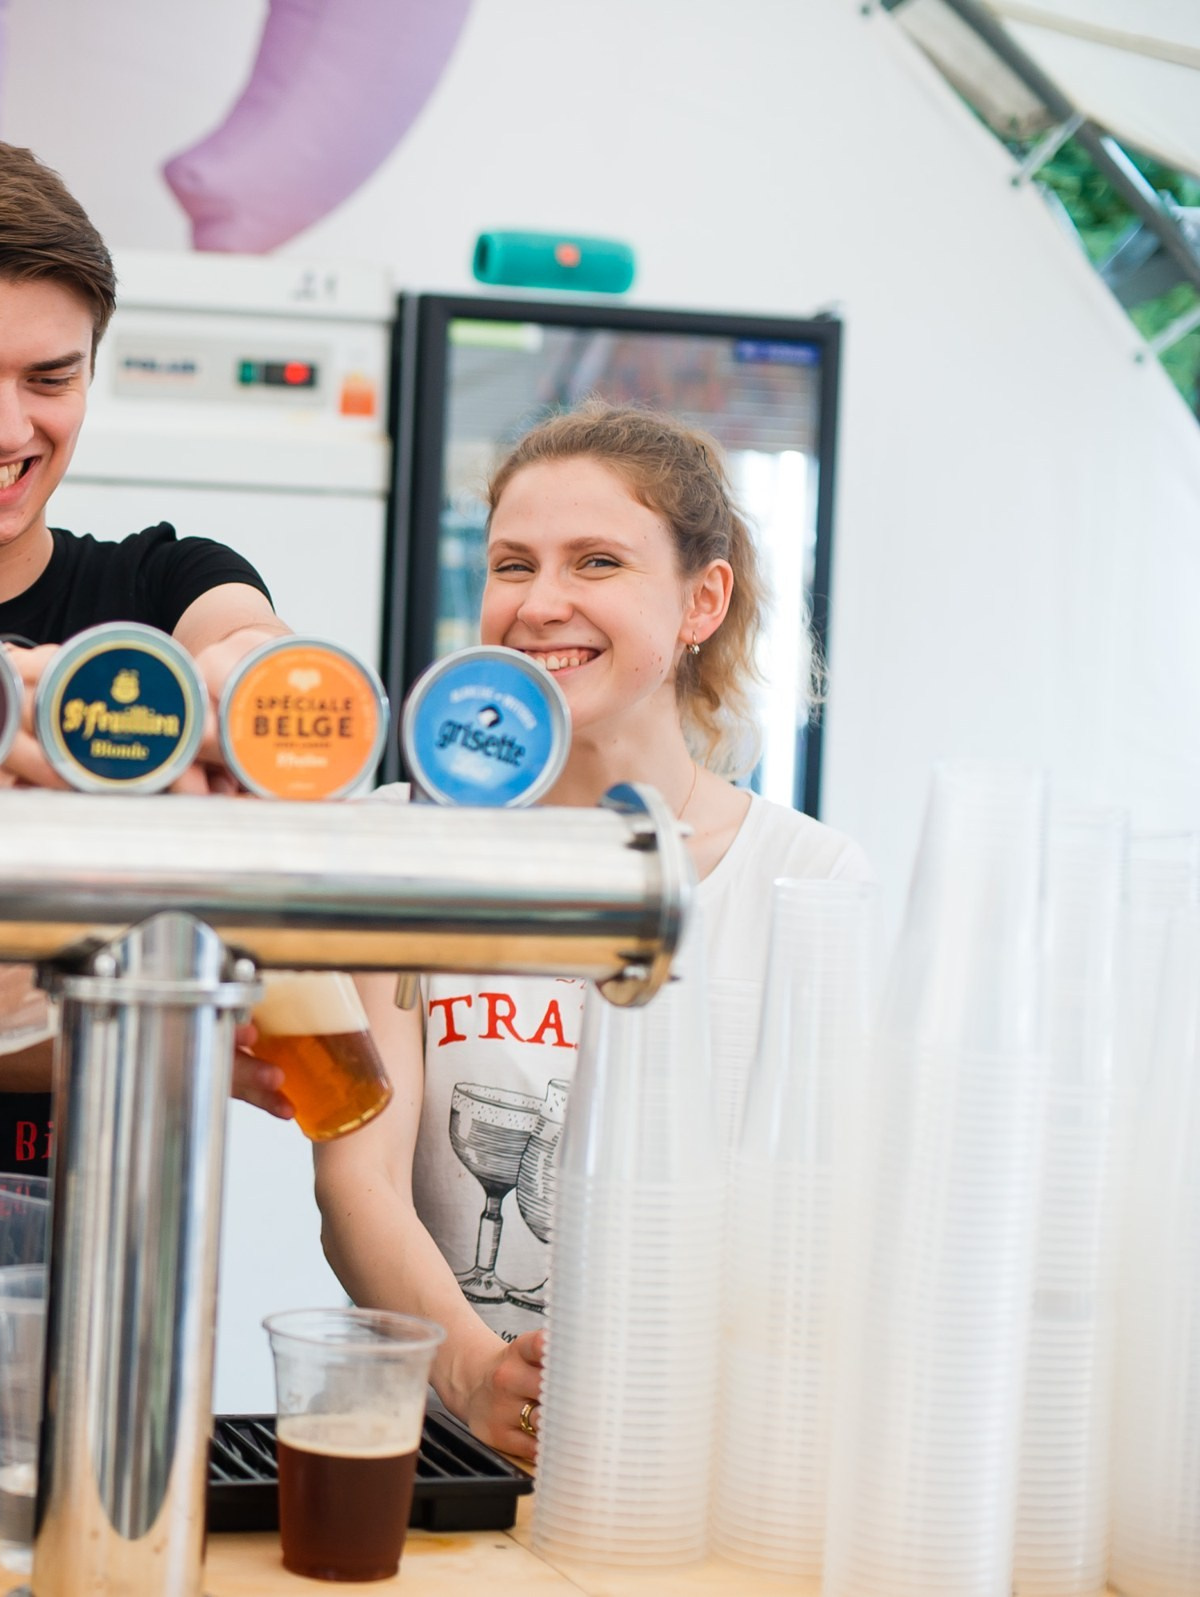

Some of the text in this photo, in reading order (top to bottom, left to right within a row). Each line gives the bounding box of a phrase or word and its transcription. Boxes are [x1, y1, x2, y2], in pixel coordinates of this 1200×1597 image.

[255, 694, 353, 711] SPÉCIALE
[253, 715, 353, 737] BELGE
[90, 739, 149, 760] Blonde
[429, 992, 580, 1048] TRA
